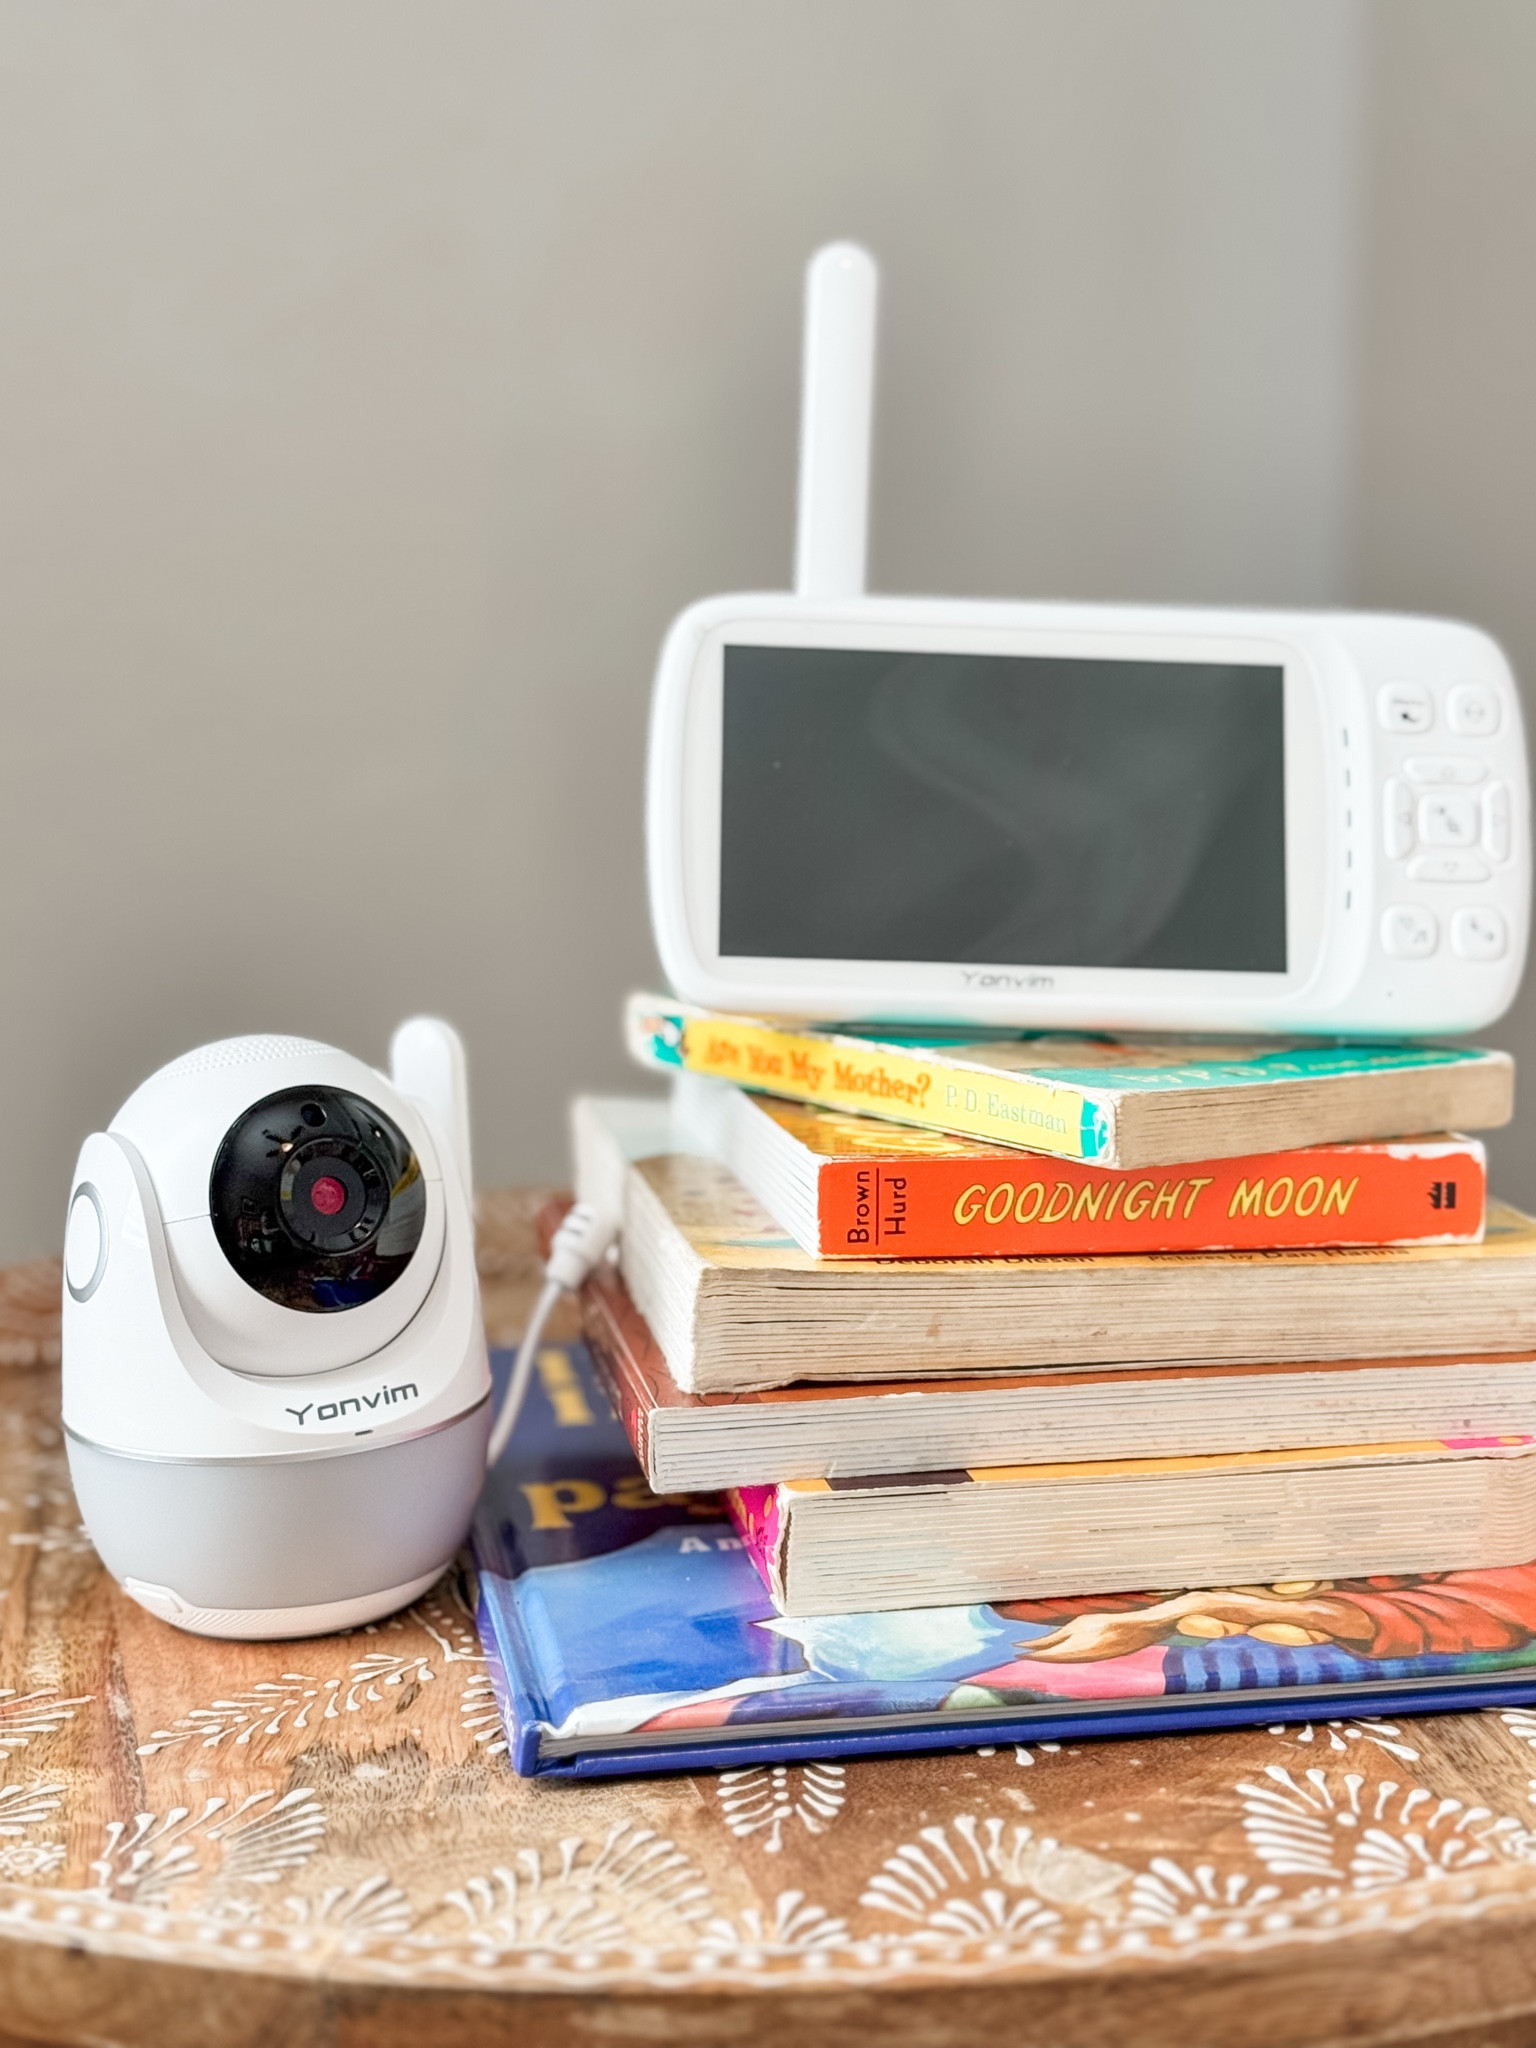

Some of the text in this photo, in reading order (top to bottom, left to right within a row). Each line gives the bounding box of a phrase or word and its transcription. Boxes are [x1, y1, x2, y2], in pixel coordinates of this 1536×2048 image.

[961, 970, 1054, 988] Yonvim
[747, 1044, 784, 1076] You
[790, 1051, 825, 1092] My
[833, 1060, 932, 1109] Mother?
[945, 1084, 958, 1108] P.
[964, 1088, 982, 1114] D.
[986, 1091, 1068, 1135] Eastman
[846, 1170, 870, 1244] Brown
[883, 1177, 907, 1236] Hurd
[953, 1175, 1361, 1225] GOODNIGHT MOON
[1148, 1253, 1226, 1263] Pictures
[1229, 1252, 1254, 1262] by
[1260, 1249, 1316, 1260] Dan
[285, 1383, 419, 1426] Yonvim
